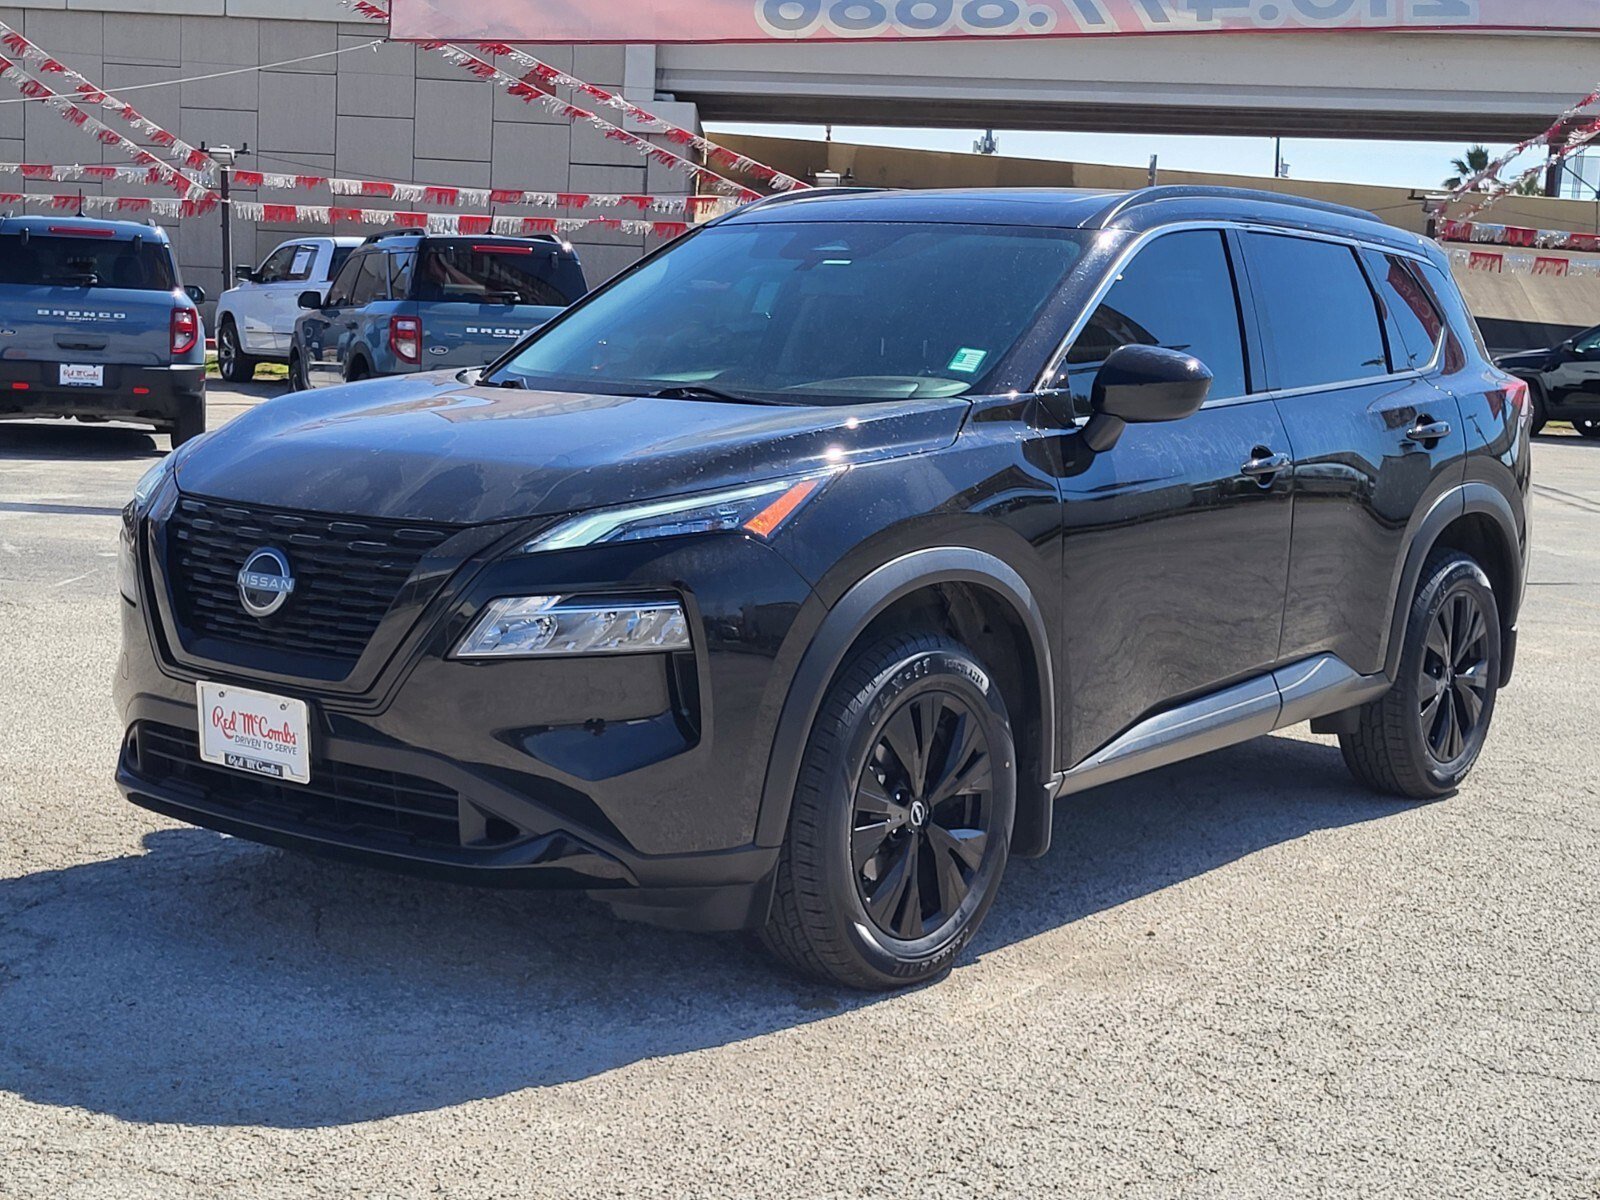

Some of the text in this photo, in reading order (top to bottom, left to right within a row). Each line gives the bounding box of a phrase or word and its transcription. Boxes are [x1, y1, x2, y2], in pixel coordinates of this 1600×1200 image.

[37, 308, 126, 319] BRONCO
[466, 327, 530, 335] BRON
[239, 572, 292, 590] NISSAN
[212, 706, 298, 746] Red McCombs
[234, 734, 298, 756] DRIVEN TO SERVE
